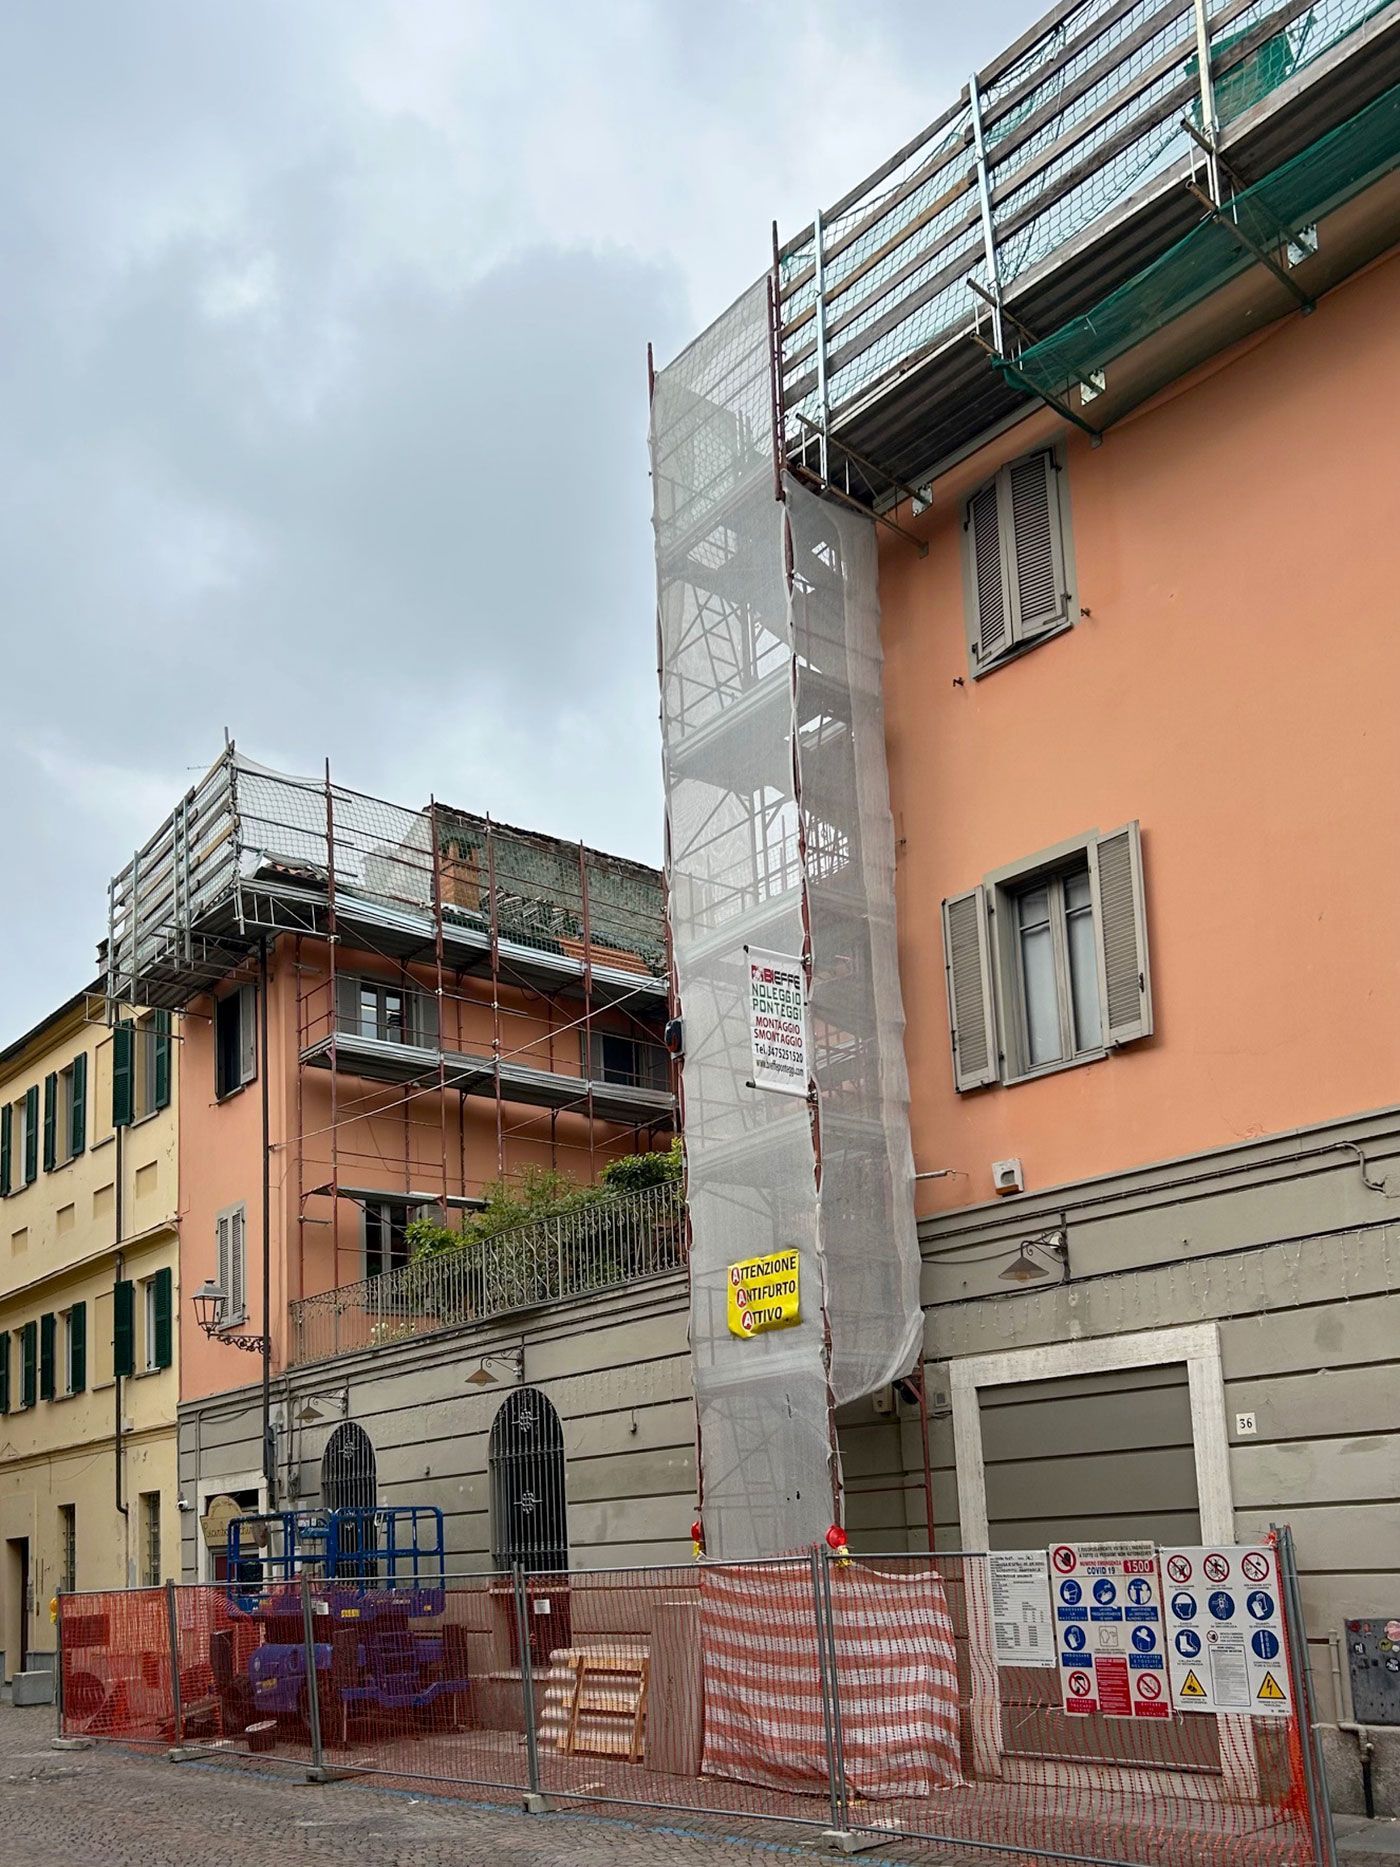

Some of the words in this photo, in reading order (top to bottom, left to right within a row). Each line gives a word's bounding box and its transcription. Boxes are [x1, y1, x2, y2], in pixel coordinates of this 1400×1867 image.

[752, 983, 802, 1006] NOLEGGIO
[752, 998, 802, 1021] PONTEGGI
[755, 1016, 801, 1035] MONTAGGIO
[754, 1028, 803, 1048] SMONTAGGIO
[731, 1256, 797, 1285] ATTENZIONE
[737, 1280, 797, 1307] ANTIFURTO
[742, 1306, 783, 1329] ATTIVO
[1239, 1417, 1253, 1429] 36
[1087, 1566, 1107, 1575] COVID
[1107, 1566, 1116, 1575] 19
[1128, 1560, 1150, 1573] 1500
